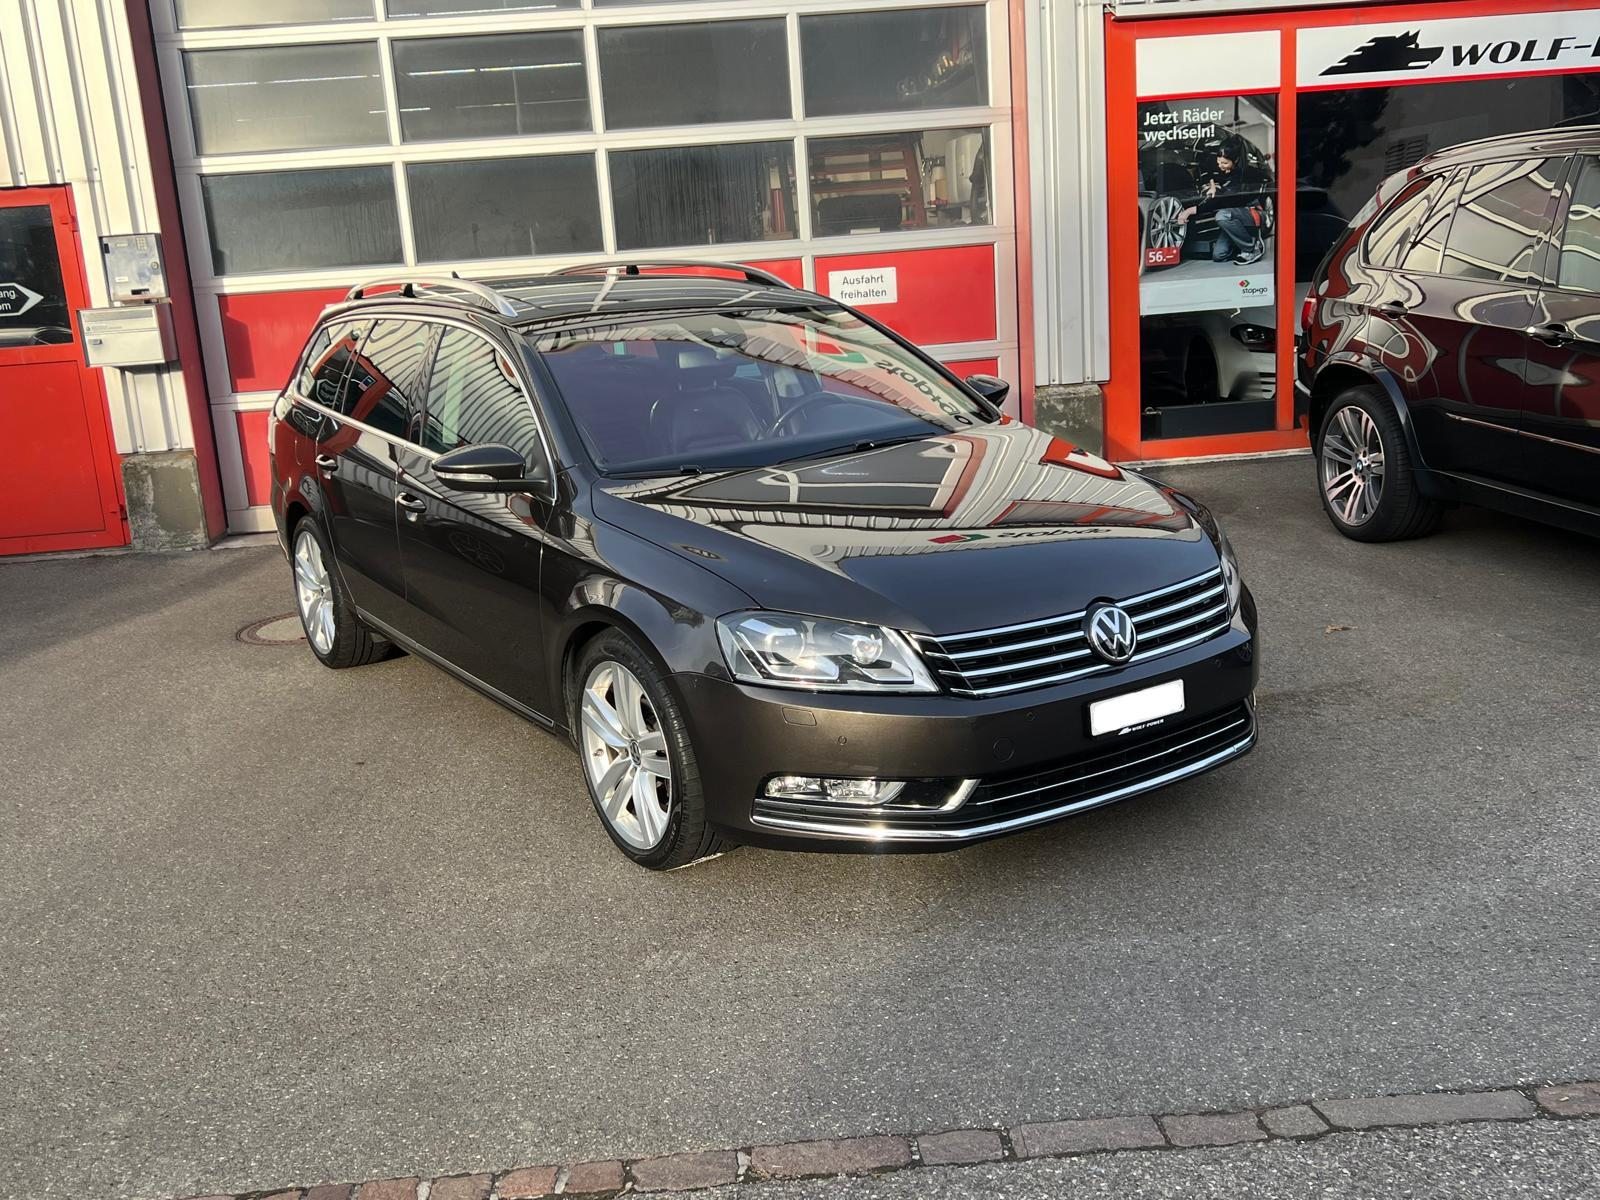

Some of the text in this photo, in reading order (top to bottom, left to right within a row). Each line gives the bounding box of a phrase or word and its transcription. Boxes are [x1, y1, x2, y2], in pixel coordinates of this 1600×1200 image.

[1452, 36, 1600, 67] WOLF-
[1143, 106, 1225, 126] Jetzt Räder
[1143, 124, 1215, 142] wechseln!
[842, 274, 884, 286] Ausfahrt
[840, 288, 887, 299] freihalten
